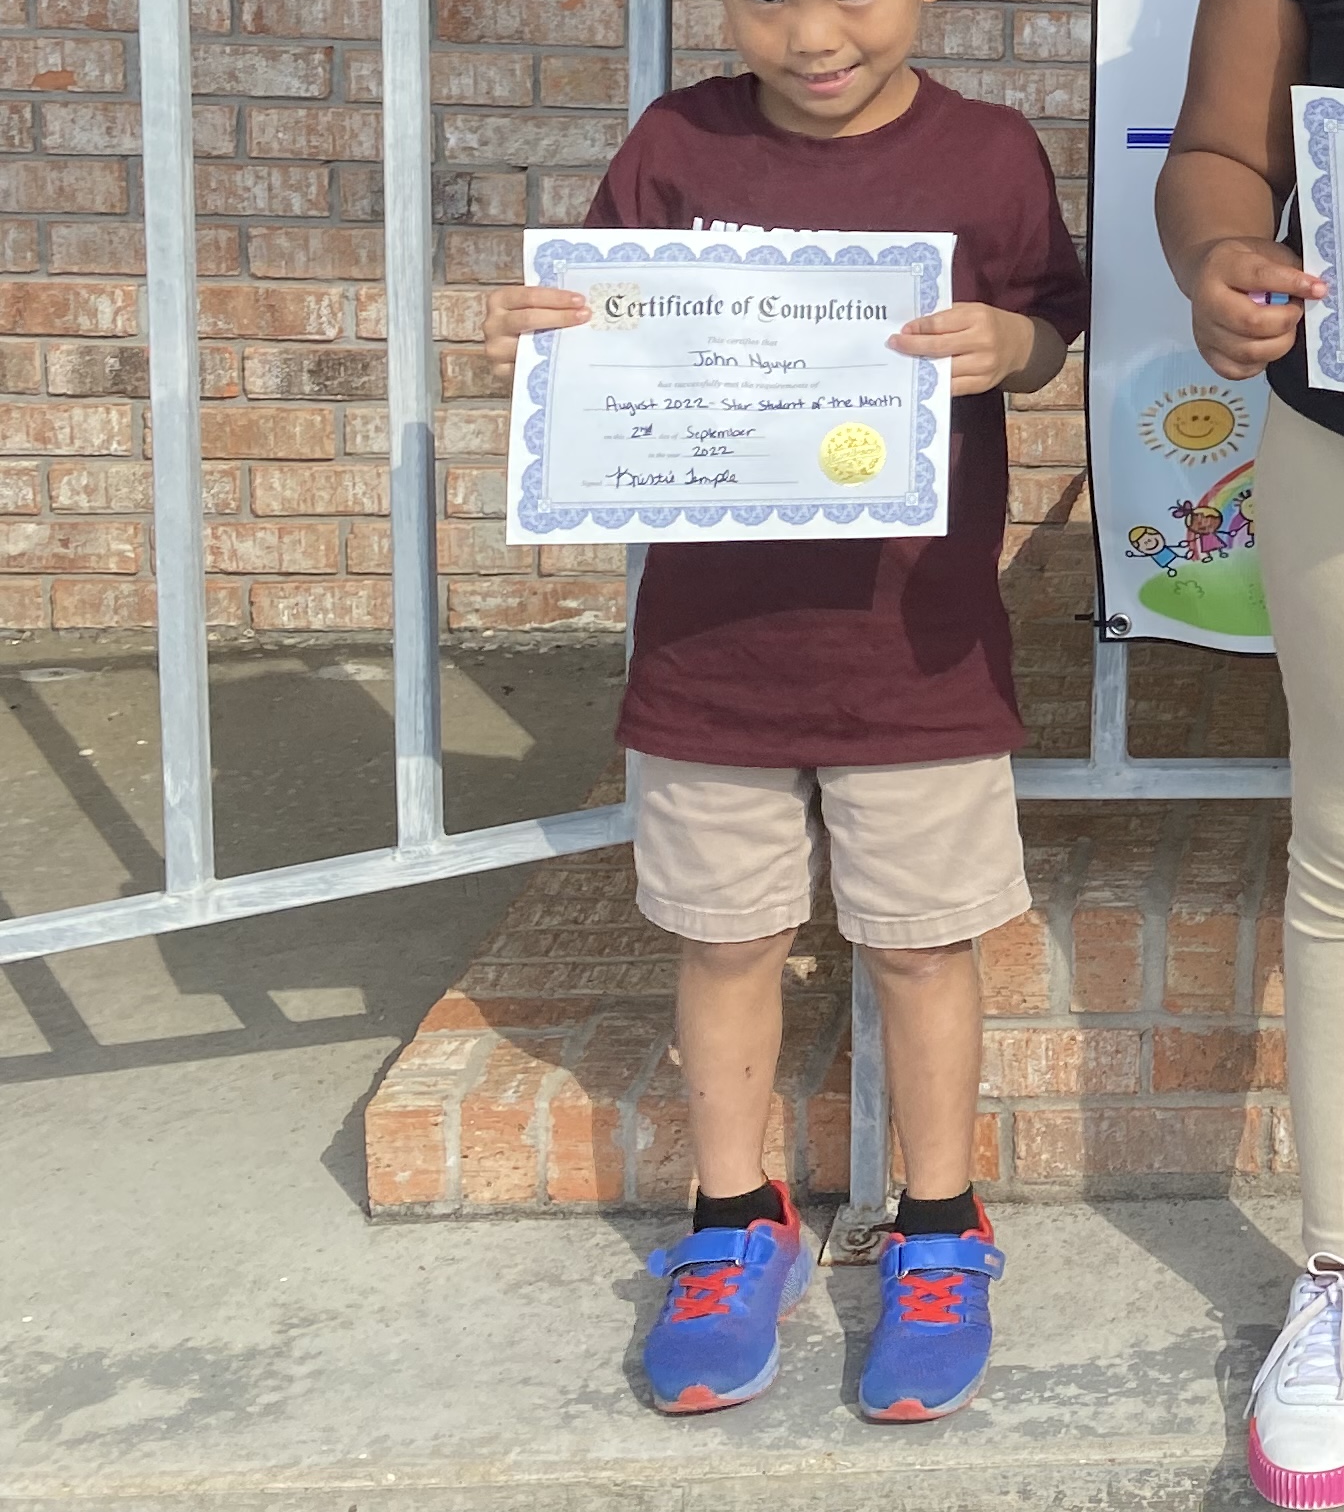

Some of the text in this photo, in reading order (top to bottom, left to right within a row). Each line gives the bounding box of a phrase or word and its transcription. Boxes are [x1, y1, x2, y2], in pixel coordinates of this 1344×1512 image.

[605, 294, 888, 324] Certificate of Completion
[688, 350, 807, 374] John Nguyen
[605, 396, 658, 416] August
[828, 397, 853, 408] the
[692, 446, 734, 457] 2022
